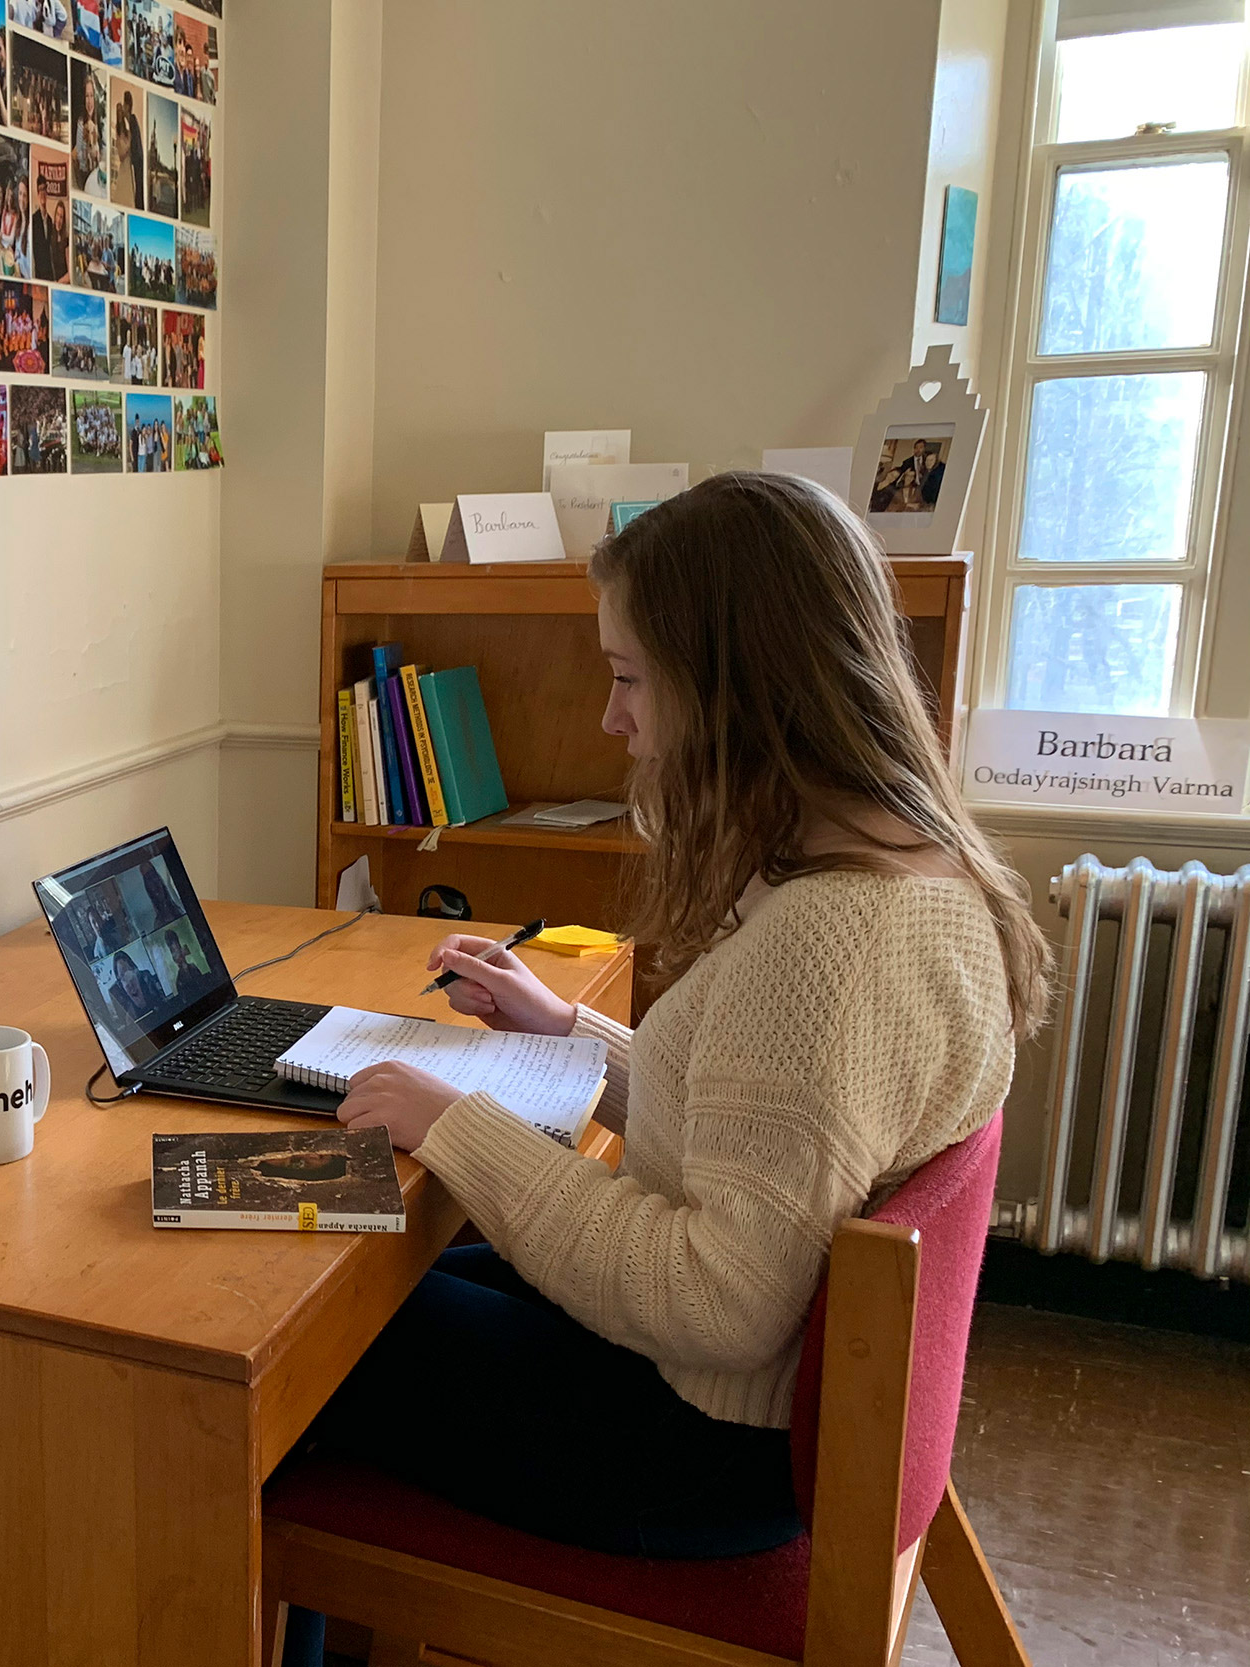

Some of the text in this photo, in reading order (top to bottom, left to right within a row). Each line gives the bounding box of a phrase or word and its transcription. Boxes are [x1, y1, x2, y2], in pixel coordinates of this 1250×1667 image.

[469, 512, 540, 534] Barbara
[406, 673, 417, 703] RESEARCH
[340, 713, 349, 732] How
[410, 704, 424, 732] METHODS
[341, 735, 349, 767] Finance
[419, 739, 433, 776] PSYCHOLOGY
[1036, 730, 1173, 763] Barbara
[342, 768, 351, 794] Works
[973, 765, 1234, 798] Oedayrajsingh Varma
[178, 1158, 192, 1205] Nathacha
[191, 1150, 210, 1200] Appanah
[216, 1166, 228, 1205] Le dernier
[262, 1213, 293, 1221] dernier
[302, 1206, 315, 1230] SED
[316, 1222, 388, 1232] Nathacha Appan
